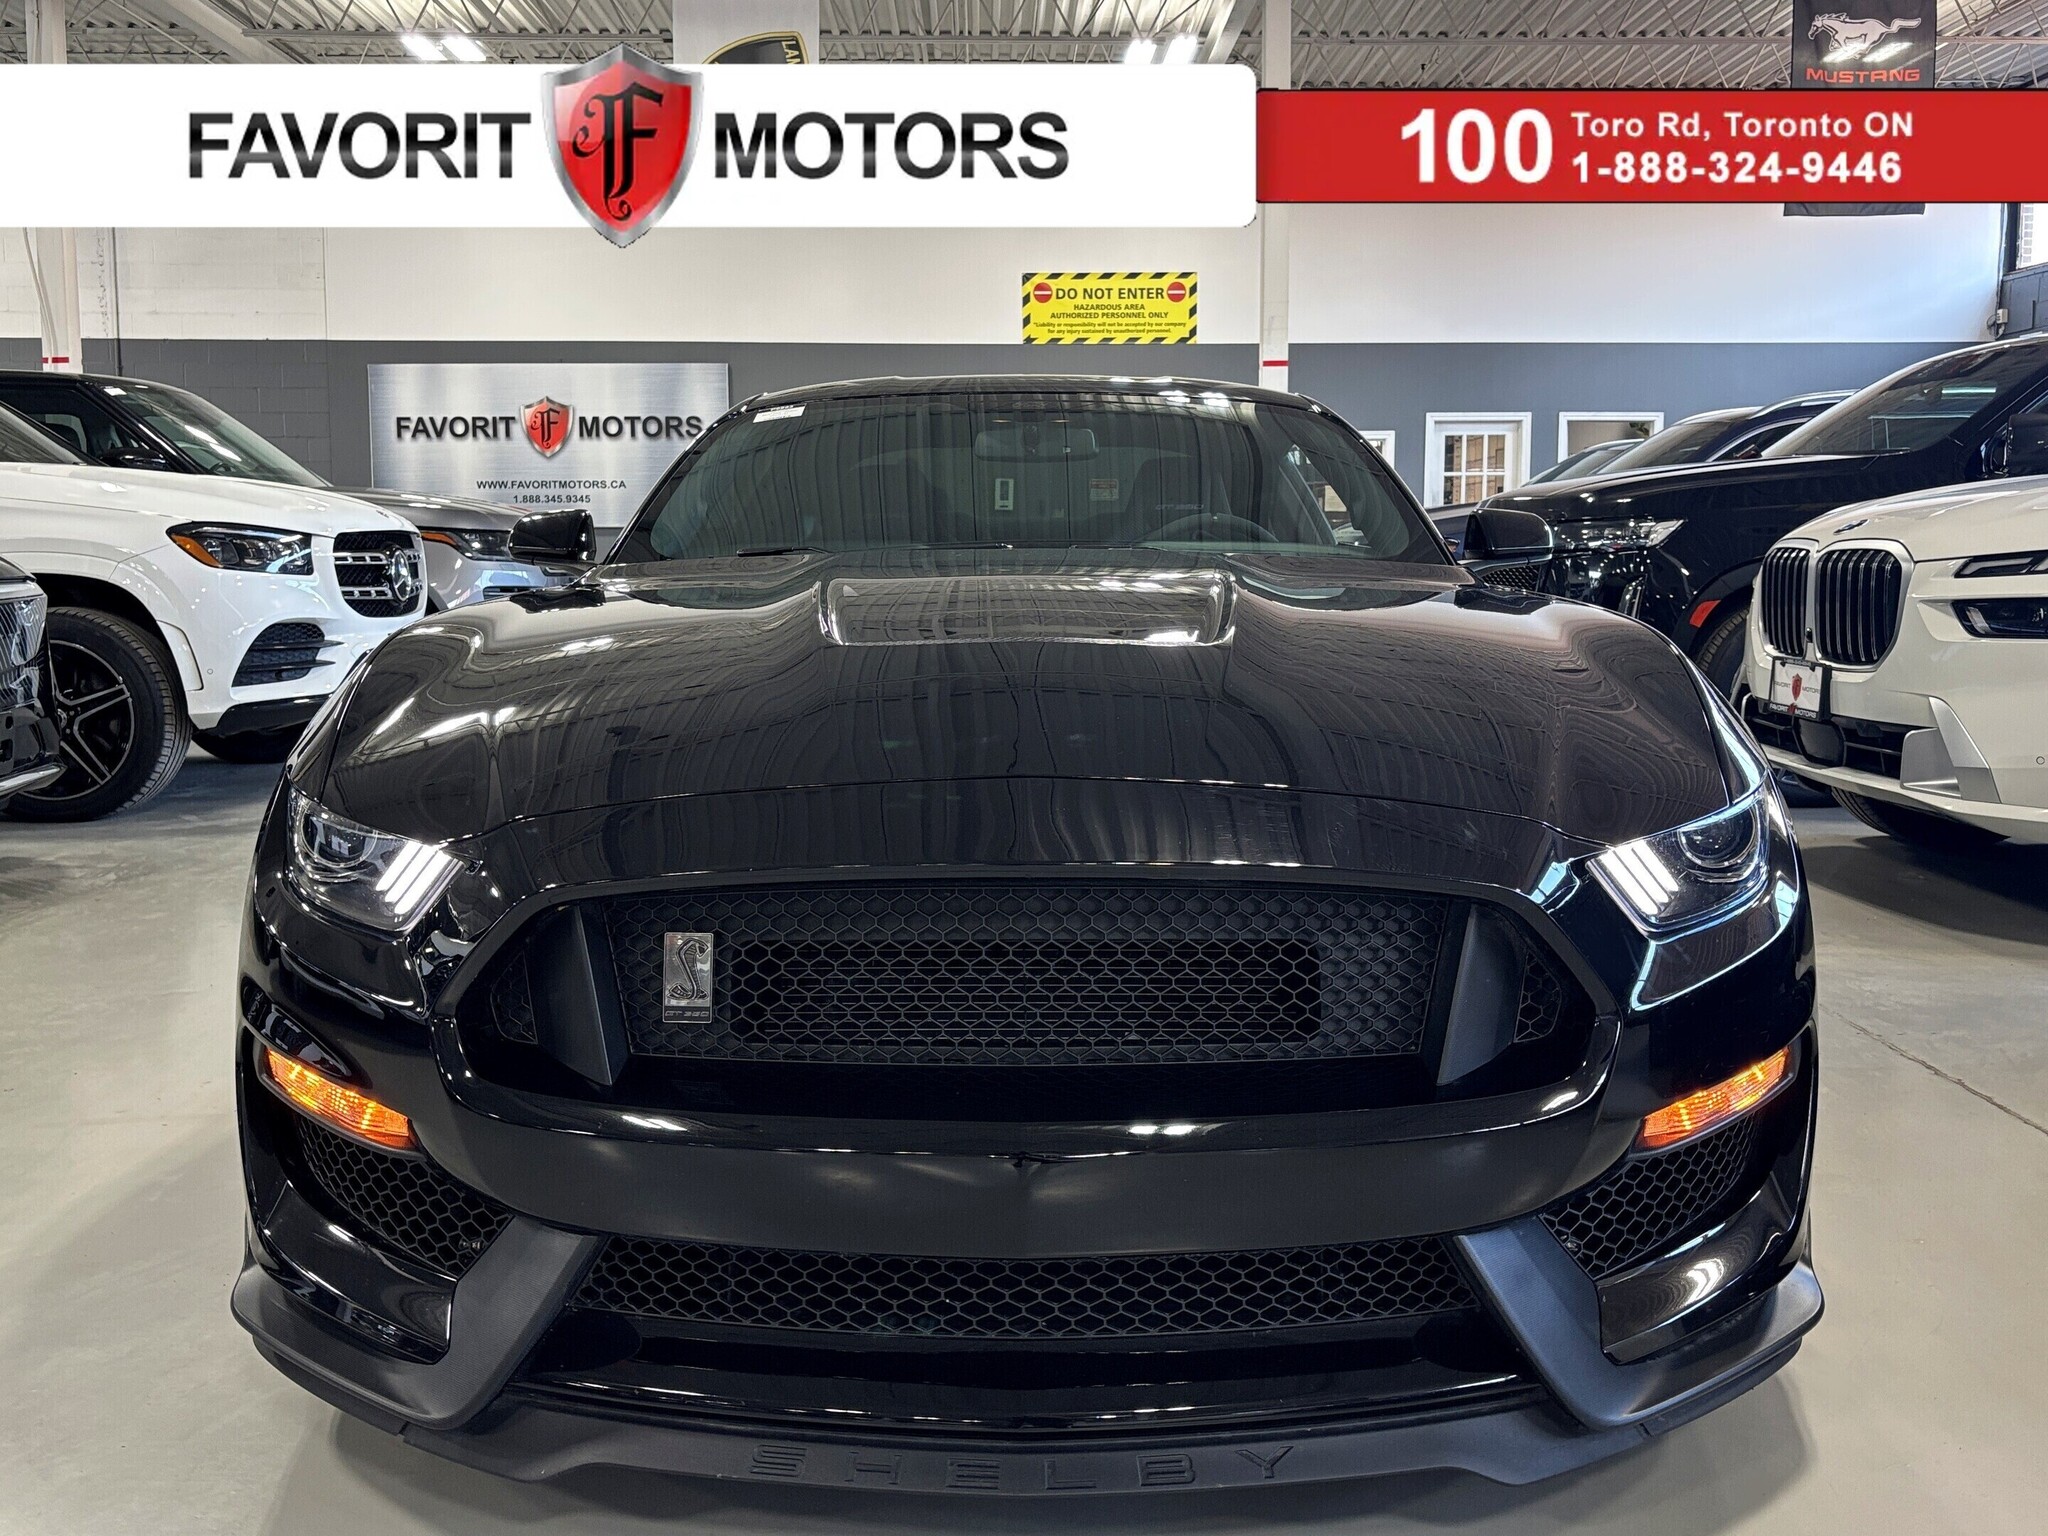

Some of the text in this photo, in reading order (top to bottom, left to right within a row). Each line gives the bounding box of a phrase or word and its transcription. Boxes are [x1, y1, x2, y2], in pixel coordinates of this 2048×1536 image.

[1805, 68, 1920, 84] MUSTANG
[1055, 287, 1165, 300] DO NOT ENTER
[1148, 311, 1169, 319] ONLY
[396, 416, 516, 439] FAVORIT
[578, 415, 704, 439] MOTORS
[476, 480, 627, 490] WWW.FAVORITMOTORS.CA
[513, 494, 591, 504] 1.888.345.9345
[748, 1443, 1295, 1492] SHELBY
